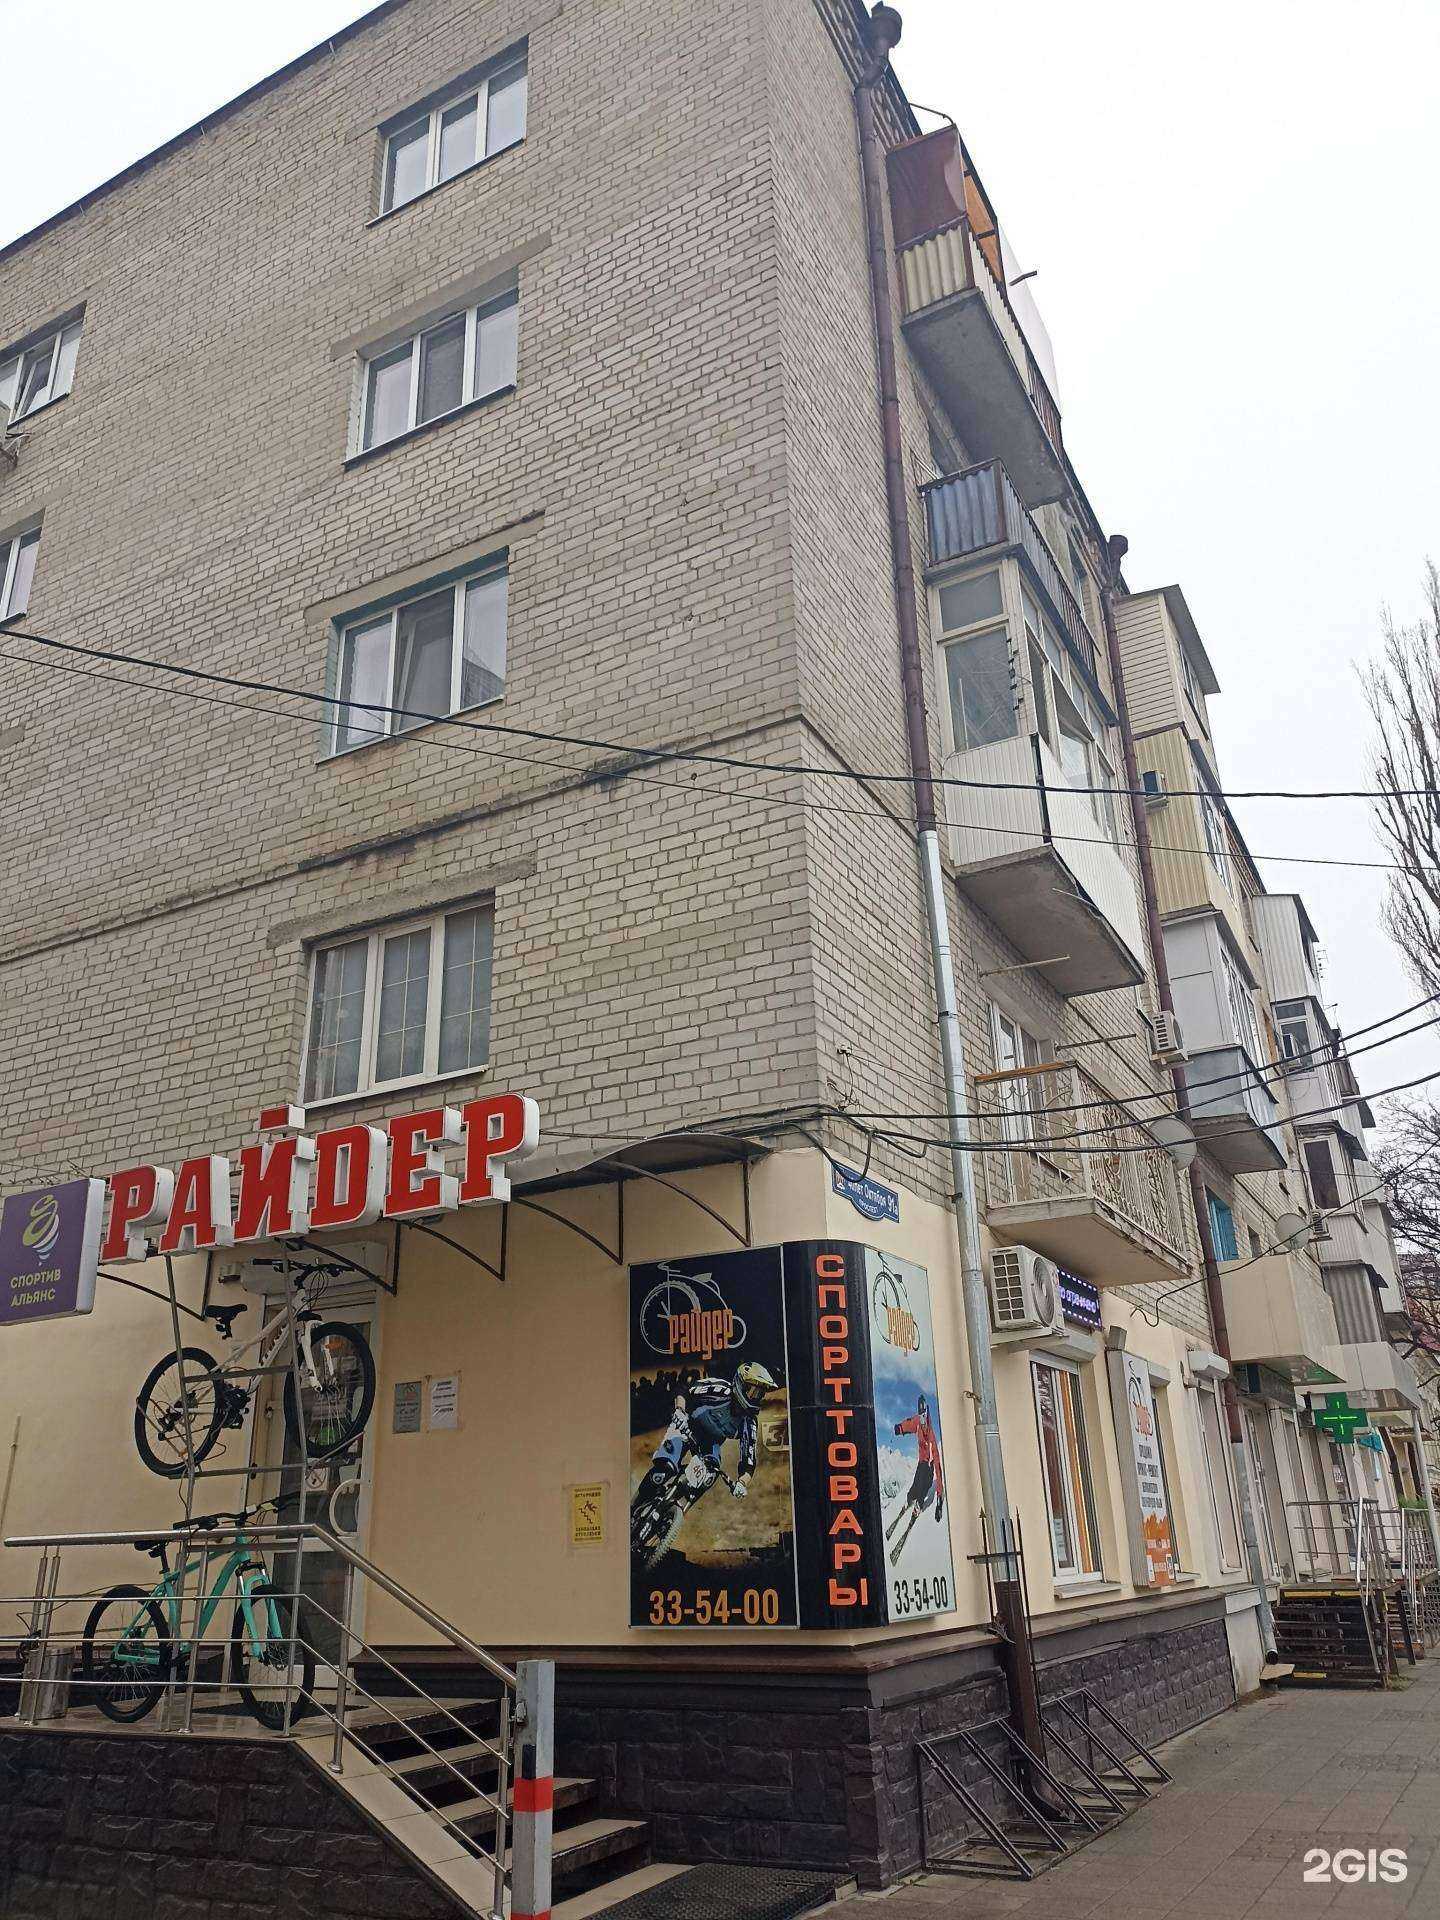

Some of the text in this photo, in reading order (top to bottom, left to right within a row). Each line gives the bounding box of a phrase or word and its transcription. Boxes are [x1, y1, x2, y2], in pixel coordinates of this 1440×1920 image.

[10, 1268, 61, 1289] СПОРТИВ
[10, 1288, 56, 1307] АЛЬЯНС
[815, 1253, 869, 1607] СПОРТТОВАРЫ
[649, 1588, 780, 1625] 33-54-00
[893, 1575, 949, 1615] 33-54-00
